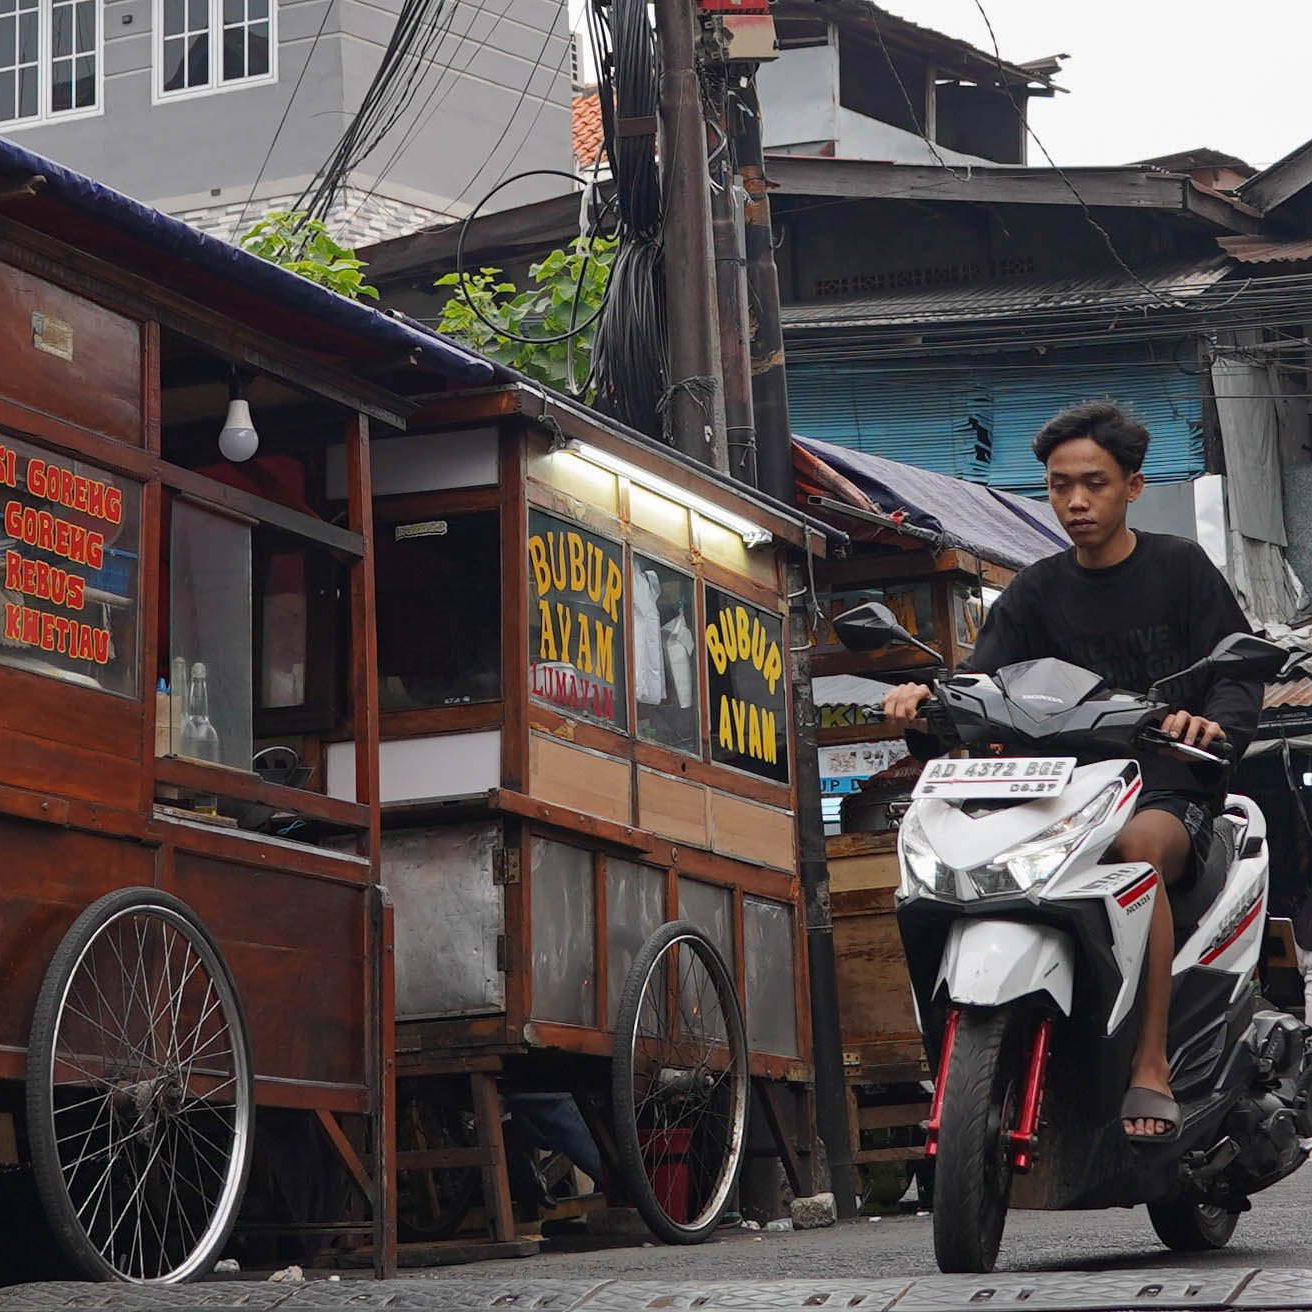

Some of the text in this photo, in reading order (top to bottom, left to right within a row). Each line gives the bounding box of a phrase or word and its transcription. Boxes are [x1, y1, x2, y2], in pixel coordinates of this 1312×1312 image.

[27, 459, 122, 524] GORENG
[4, 501, 104, 570] GORENG
[5, 549, 85, 610] REBUS
[529, 531, 622, 623] BUBUR
[5, 602, 110, 664] KWETIAU
[539, 600, 614, 684] AYAM
[705, 606, 783, 695] BUBUR
[531, 662, 615, 722] LUMAYAN
[719, 694, 777, 765] AYAM
[929, 763, 957, 778] AD
[964, 762, 1017, 777] 4372
[1024, 761, 1066, 776] BGE
